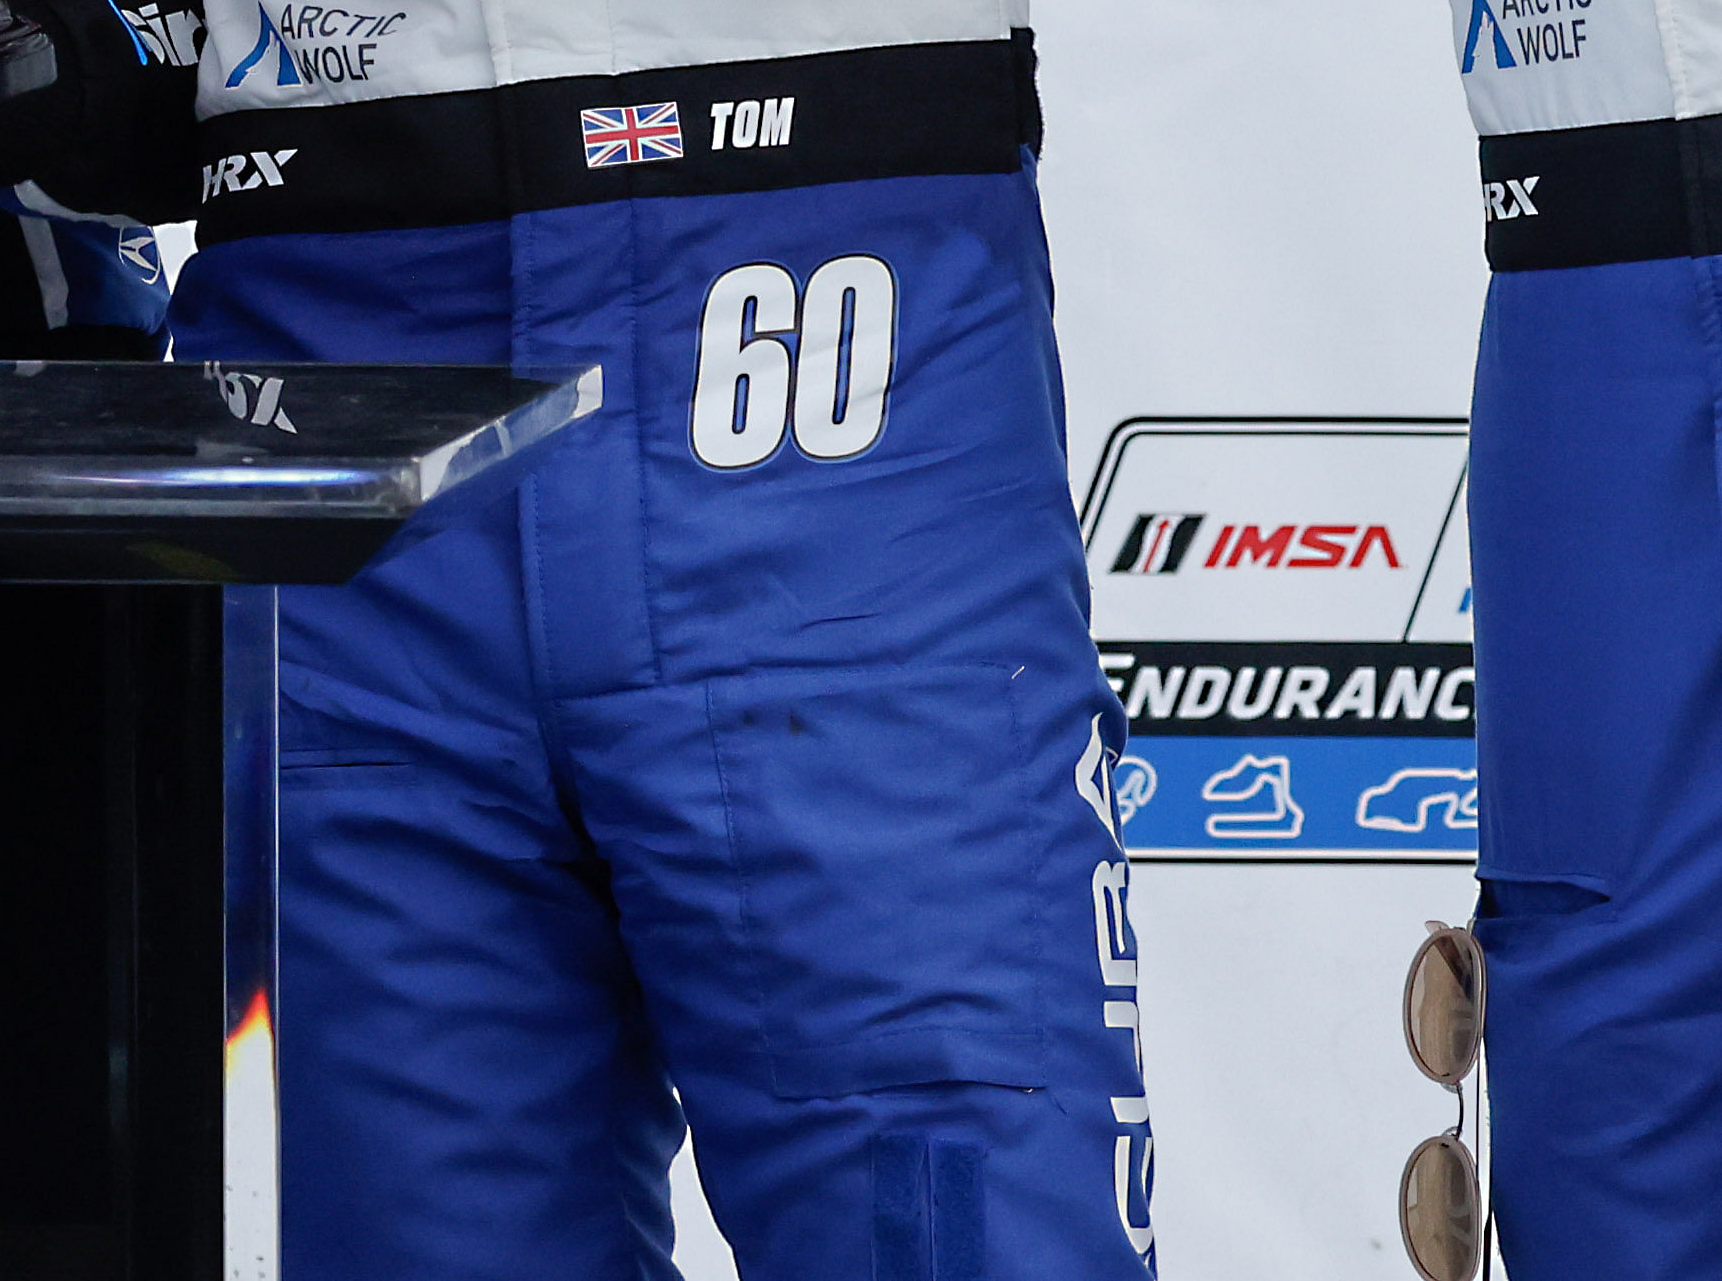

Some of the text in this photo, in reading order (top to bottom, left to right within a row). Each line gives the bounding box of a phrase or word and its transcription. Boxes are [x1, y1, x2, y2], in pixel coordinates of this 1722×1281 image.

[279, 3, 407, 39] ARCTIC
[1517, 19, 1589, 66] WOLF
[295, 43, 377, 84] WOLF
[709, 97, 796, 151] TOM
[202, 149, 298, 203] HRX
[1482, 176, 1543, 221] RX
[690, 254, 897, 471] 60
[1204, 525, 1403, 569] IMSA
